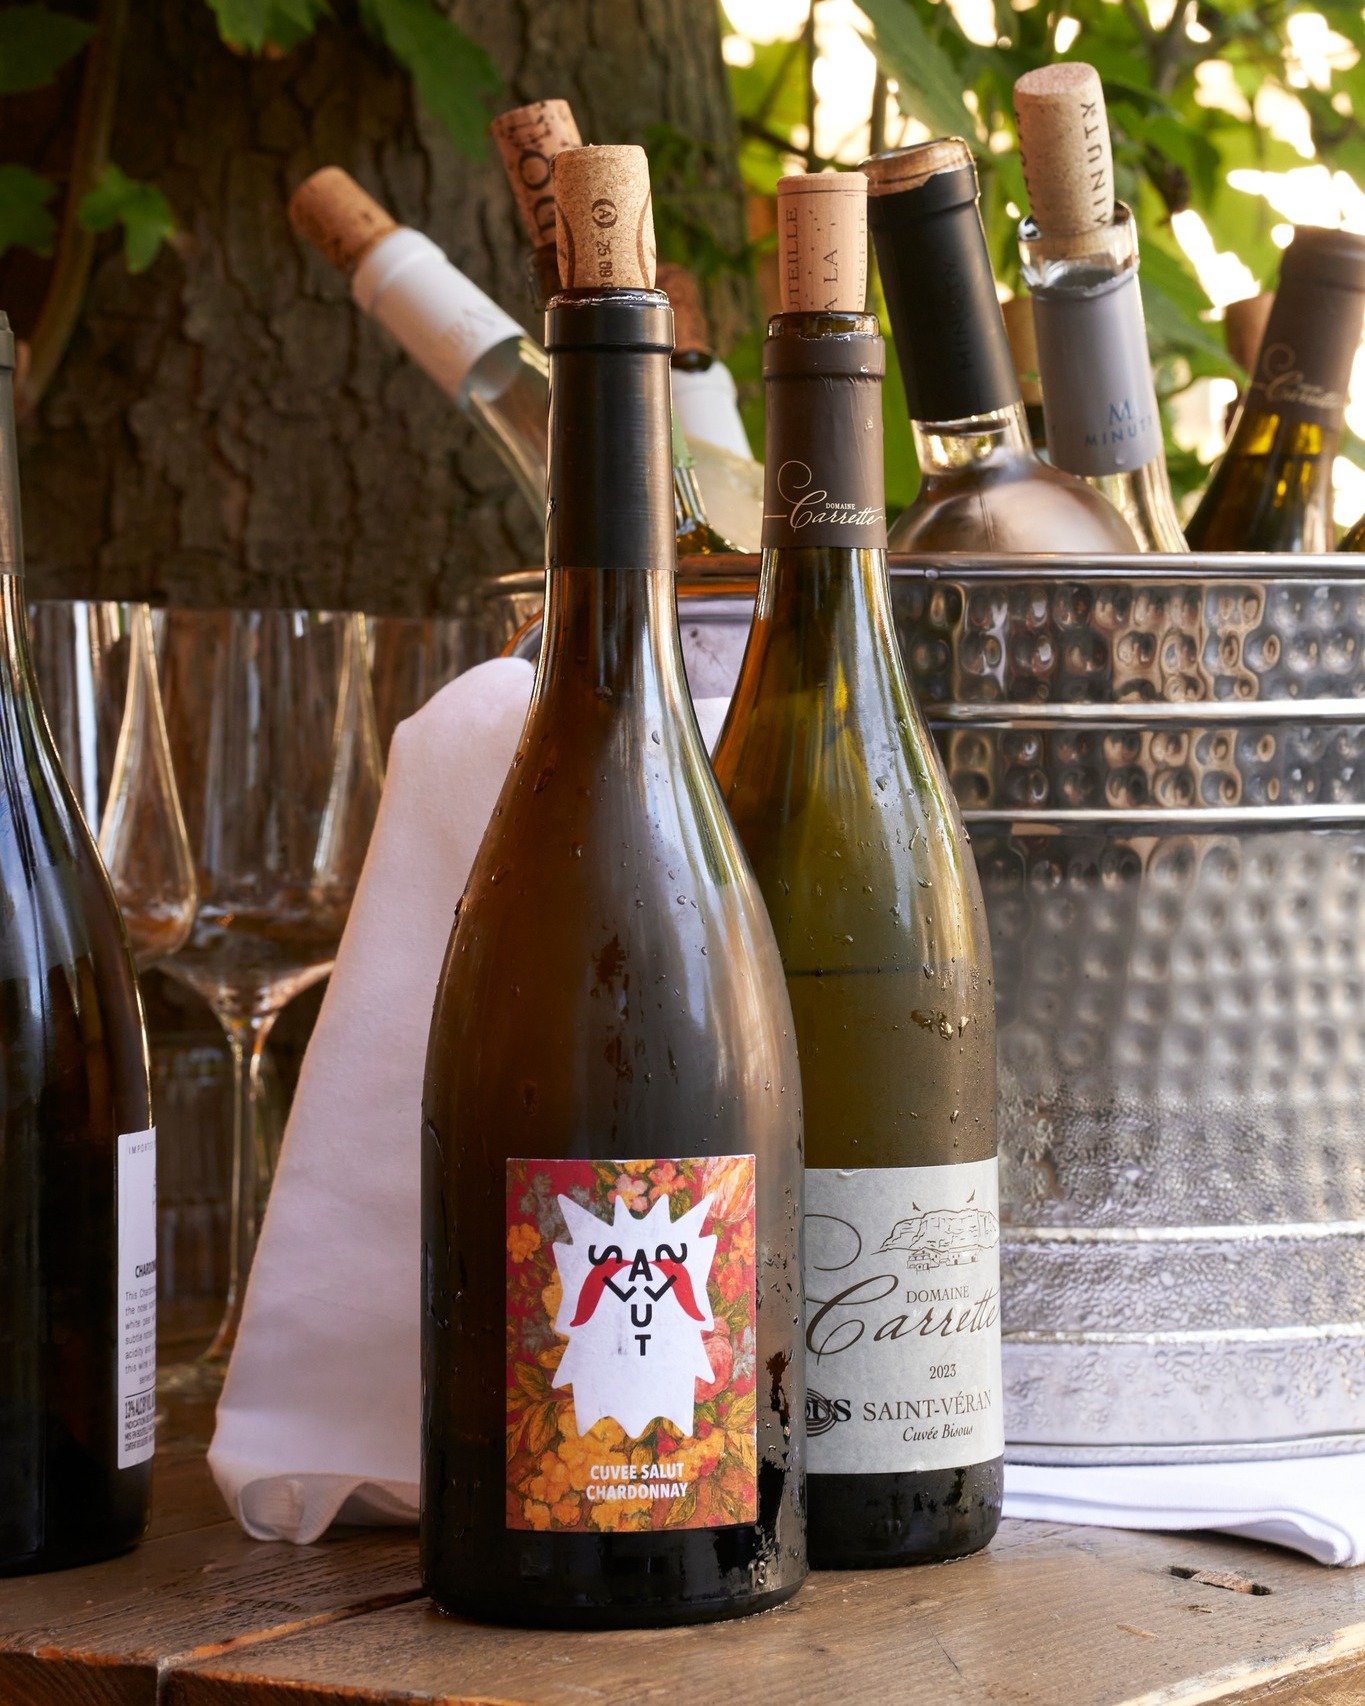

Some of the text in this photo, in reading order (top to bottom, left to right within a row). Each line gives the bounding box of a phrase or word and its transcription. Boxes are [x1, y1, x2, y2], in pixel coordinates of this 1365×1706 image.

[823, 249, 838, 283] LA
[1108, 398, 1132, 426] M
[777, 460, 887, 533] Carrette
[825, 502, 856, 510] DOMAINE
[906, 1285, 970, 1304] DOMAINE
[805, 1270, 1000, 1366] Carrette
[929, 1363, 957, 1380] 2023
[863, 1389, 992, 1421] SAINT-VÉRAN
[902, 1422, 973, 1442] Cuvée Bisous
[590, 1462, 684, 1480] CUVEE SALUT
[586, 1482, 689, 1500] CHARDONNAY
